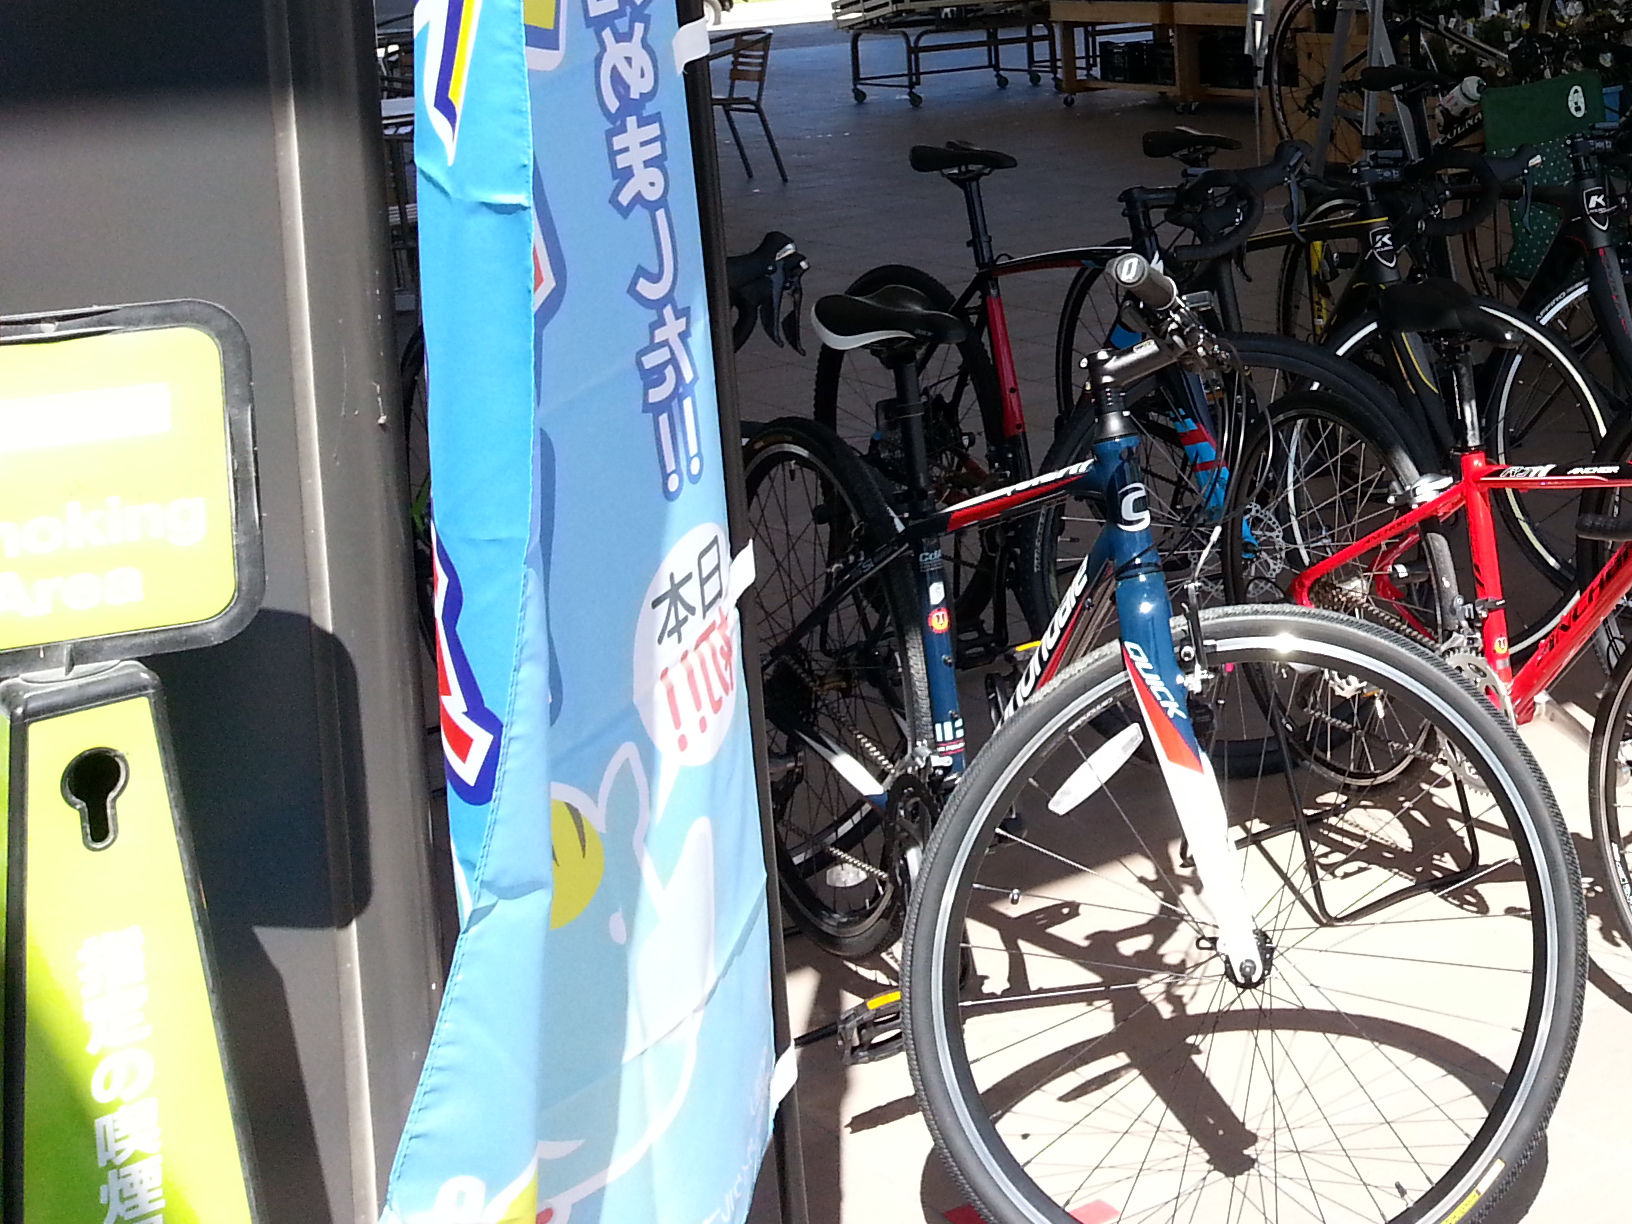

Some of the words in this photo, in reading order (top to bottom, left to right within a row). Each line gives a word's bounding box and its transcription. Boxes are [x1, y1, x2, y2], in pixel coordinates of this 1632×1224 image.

[1123, 640, 1188, 720] QUICK
[76, 924, 166, 1224] 指定の喫煙
